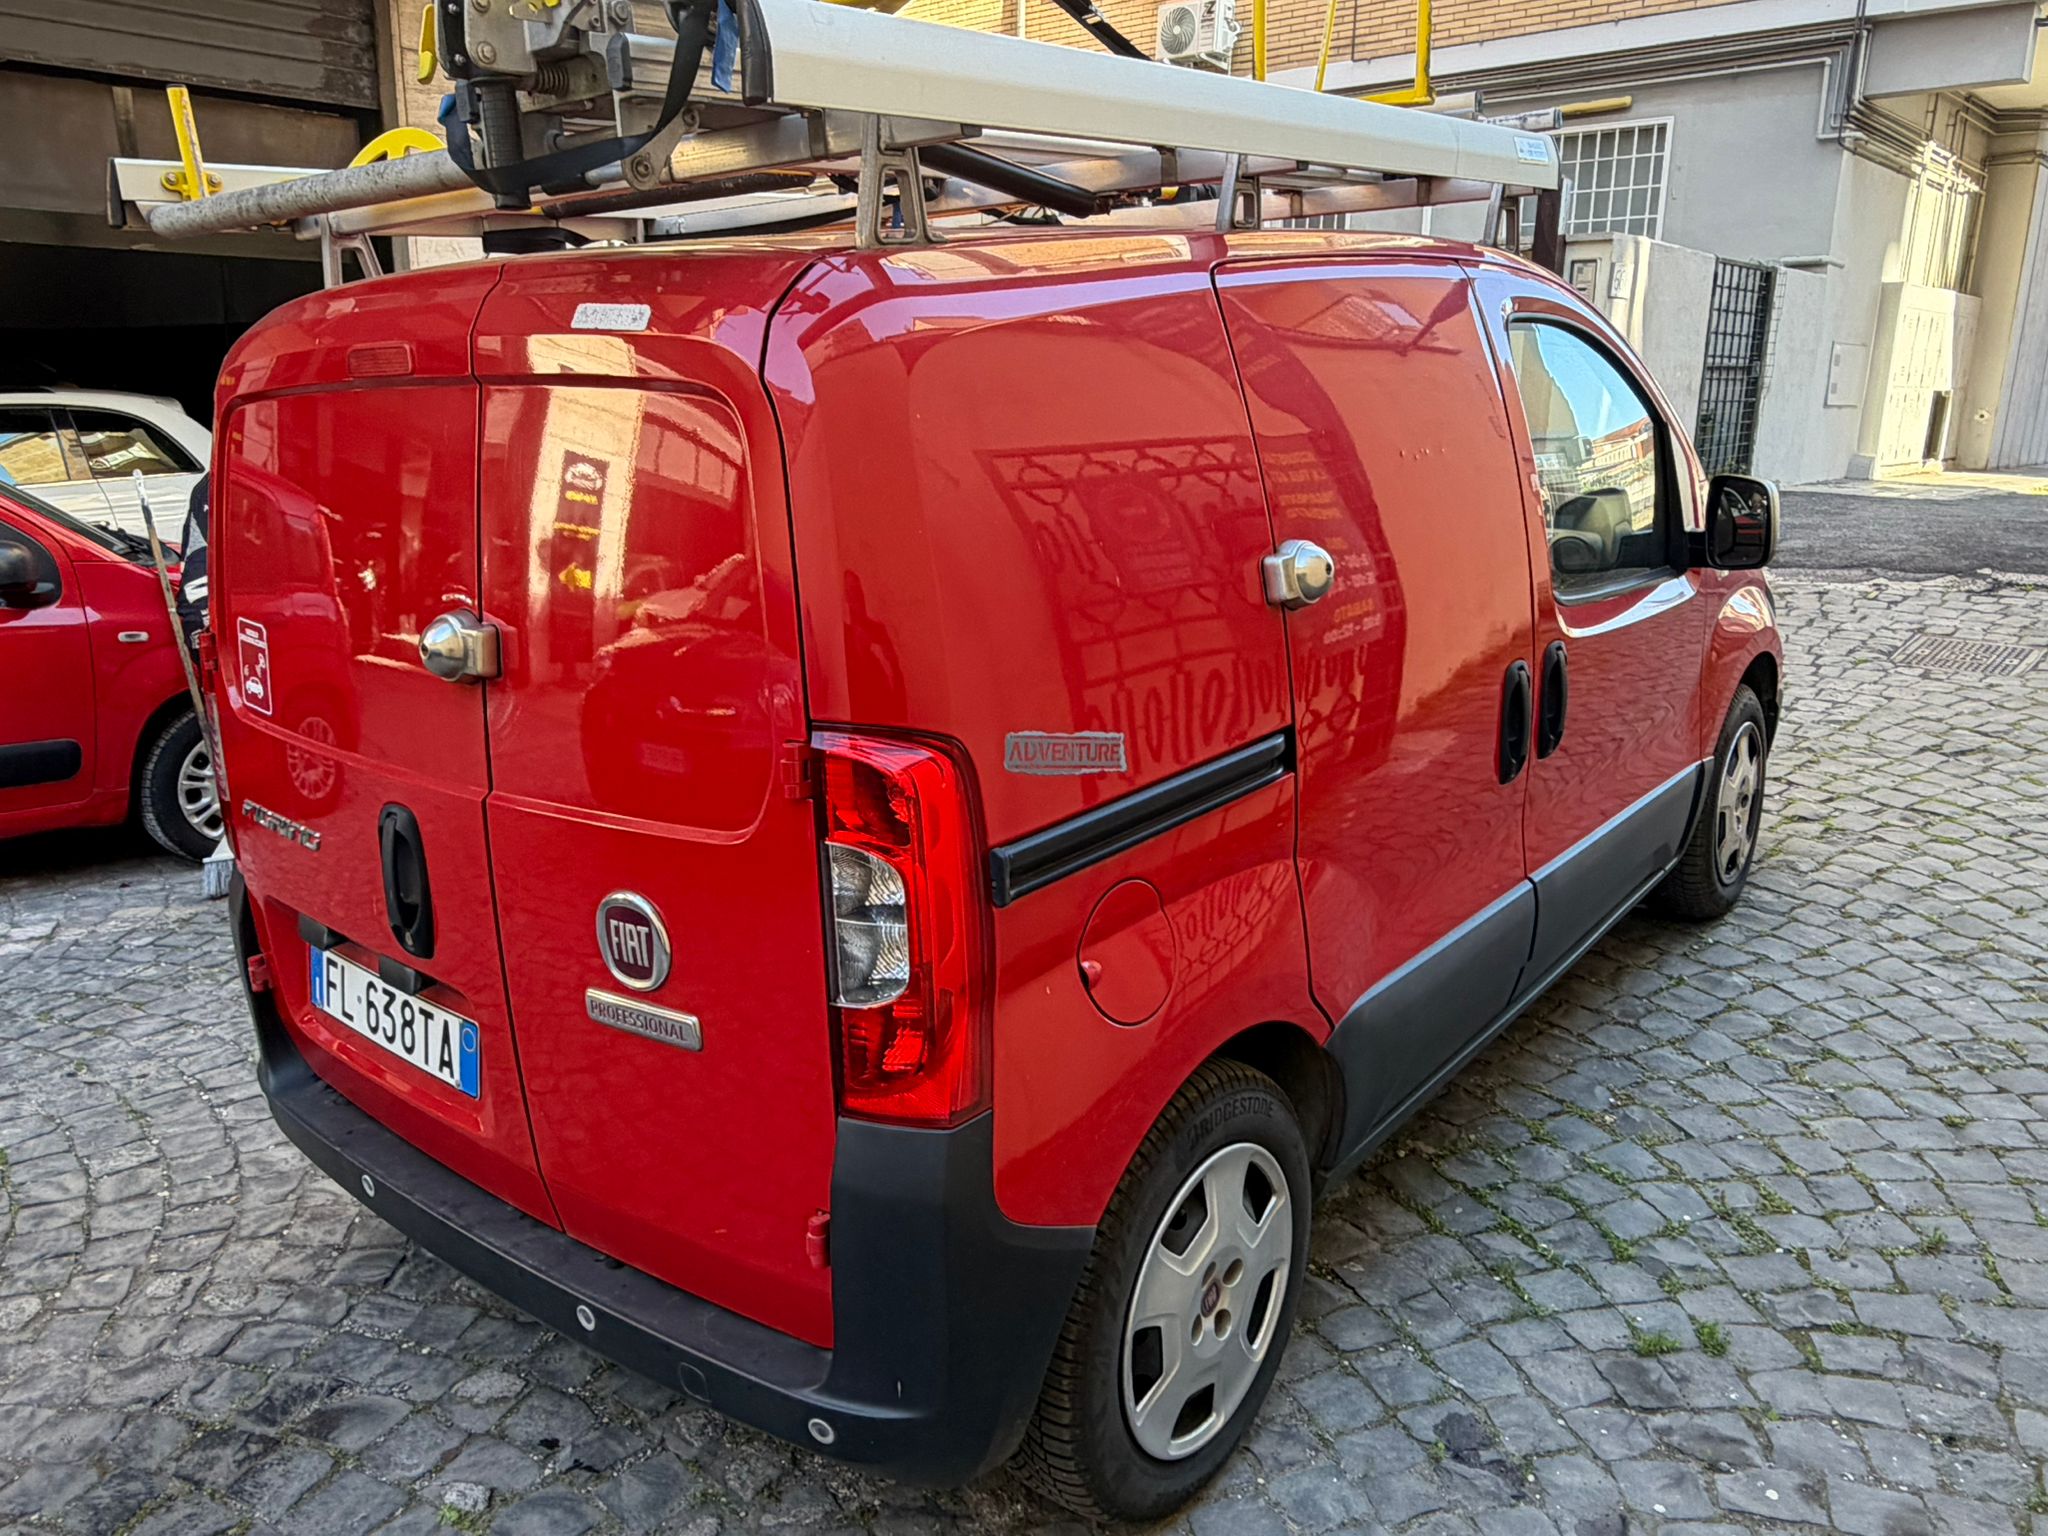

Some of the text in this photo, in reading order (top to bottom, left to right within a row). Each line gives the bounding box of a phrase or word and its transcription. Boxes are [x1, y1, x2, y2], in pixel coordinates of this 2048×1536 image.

[1009, 740, 1121, 763] ADVENTURE
[609, 918, 650, 969] FIAT
[589, 999, 689, 1042] PROFESSIONAL
